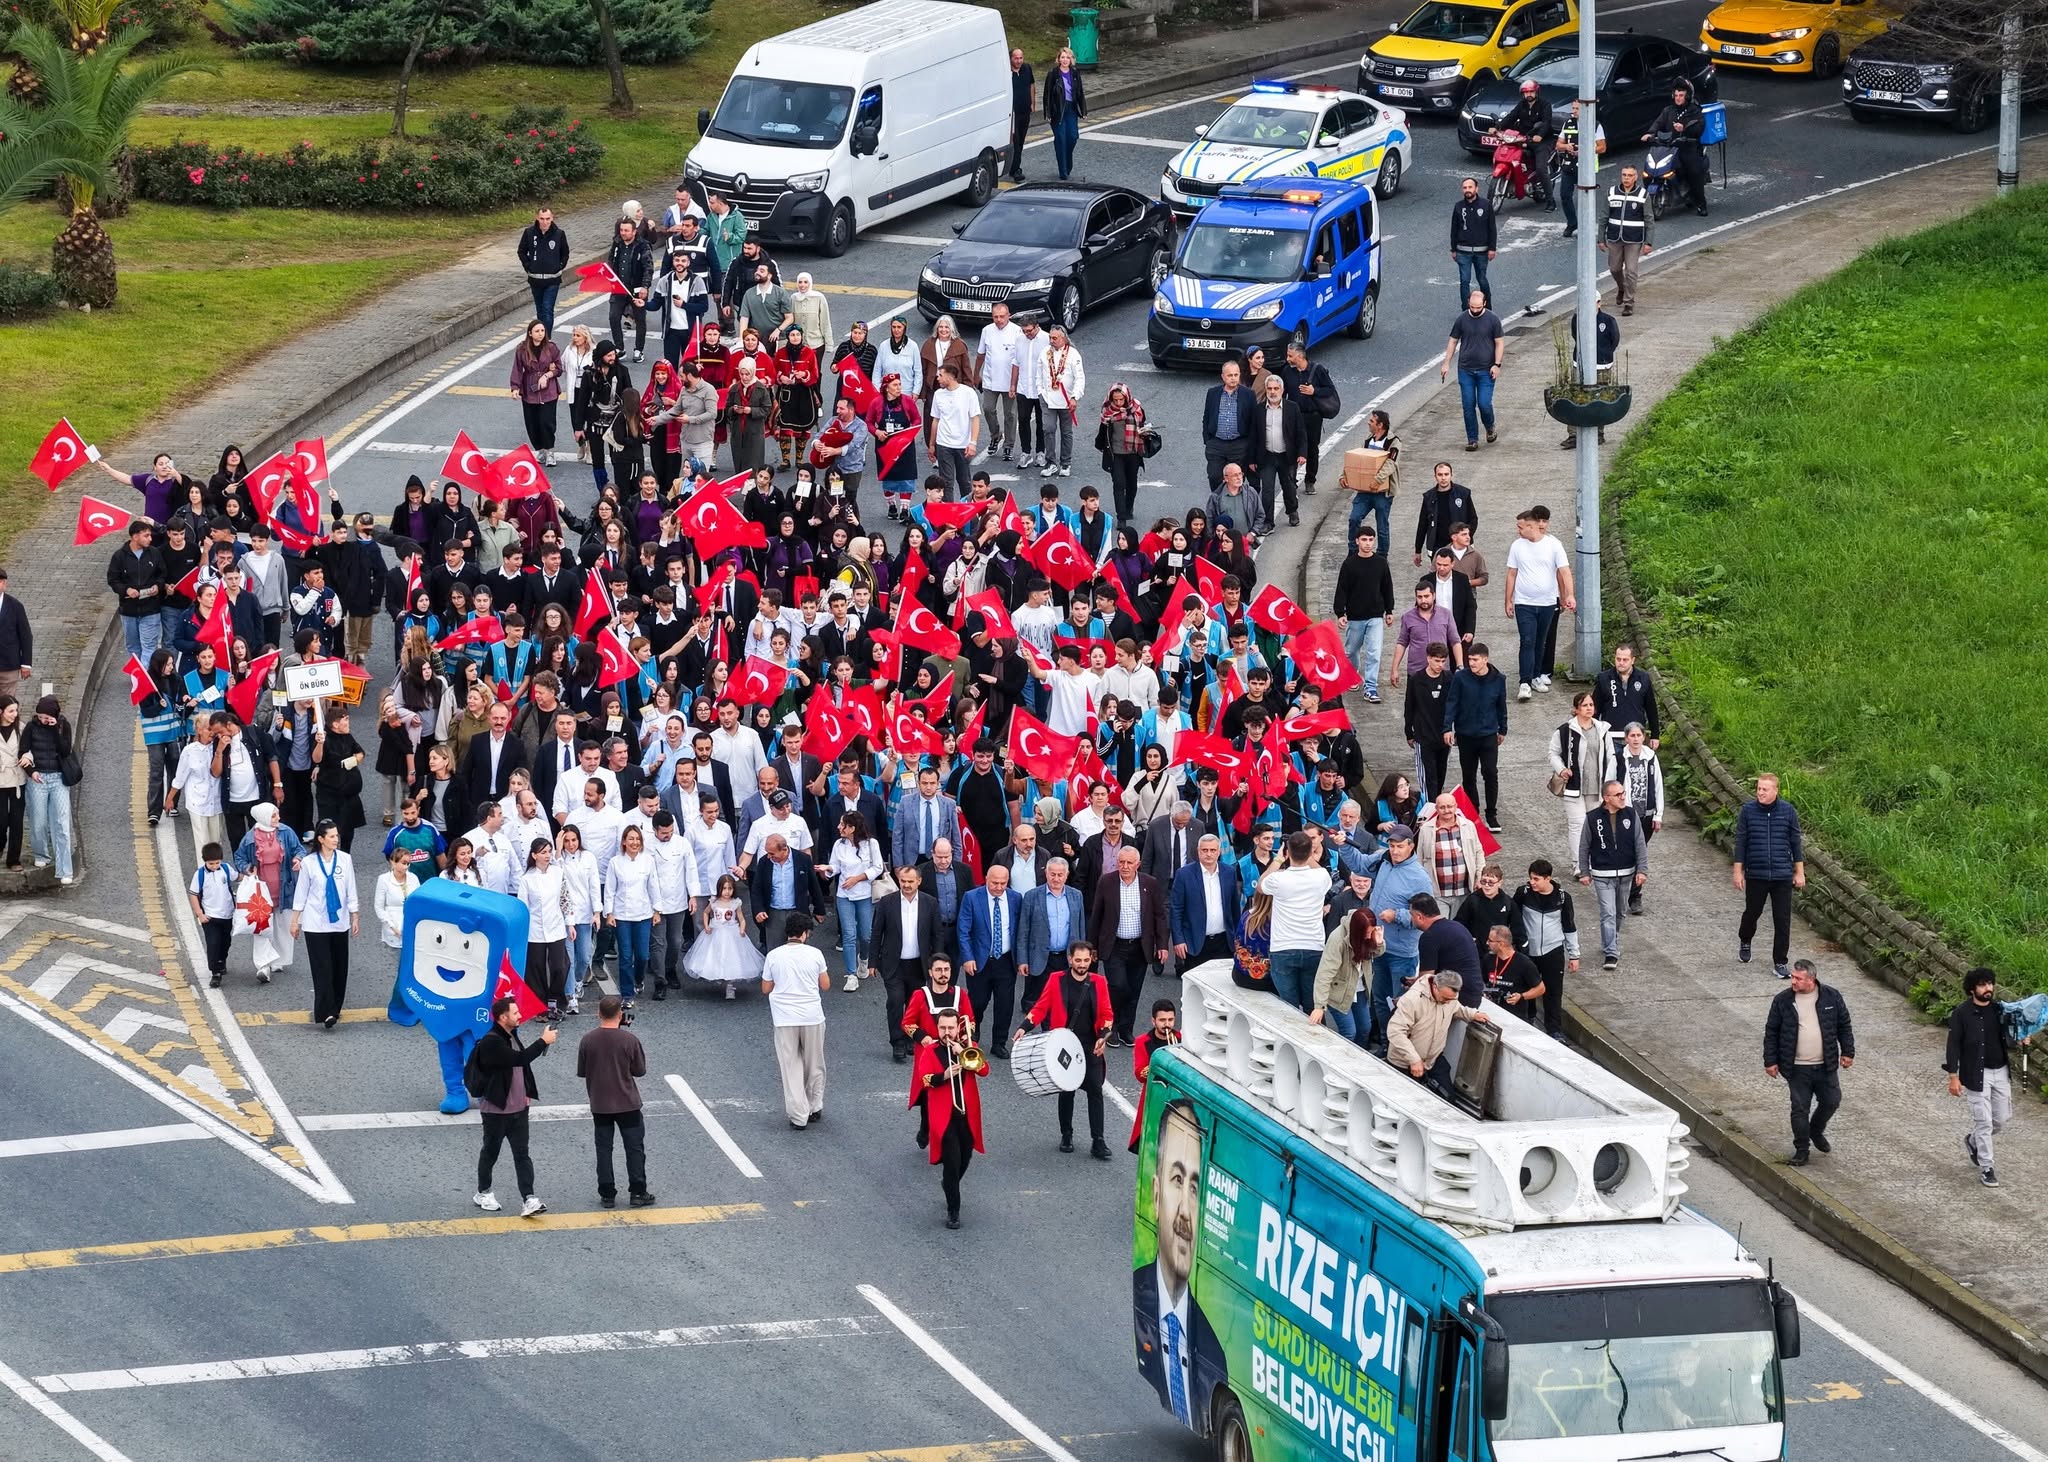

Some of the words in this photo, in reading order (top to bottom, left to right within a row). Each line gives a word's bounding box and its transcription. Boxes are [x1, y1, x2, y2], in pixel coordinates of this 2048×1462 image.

[979, 304, 991, 312] 235
[1187, 339, 1196, 347] 53
[1213, 341, 1225, 349] 124
[300, 680, 310, 690] ÖN
[311, 679, 329, 689] BÜRO
[1208, 1167, 1239, 1203] RAHMİ
[1206, 1190, 1235, 1226] METİN
[1256, 1201, 1339, 1331] RİZE
